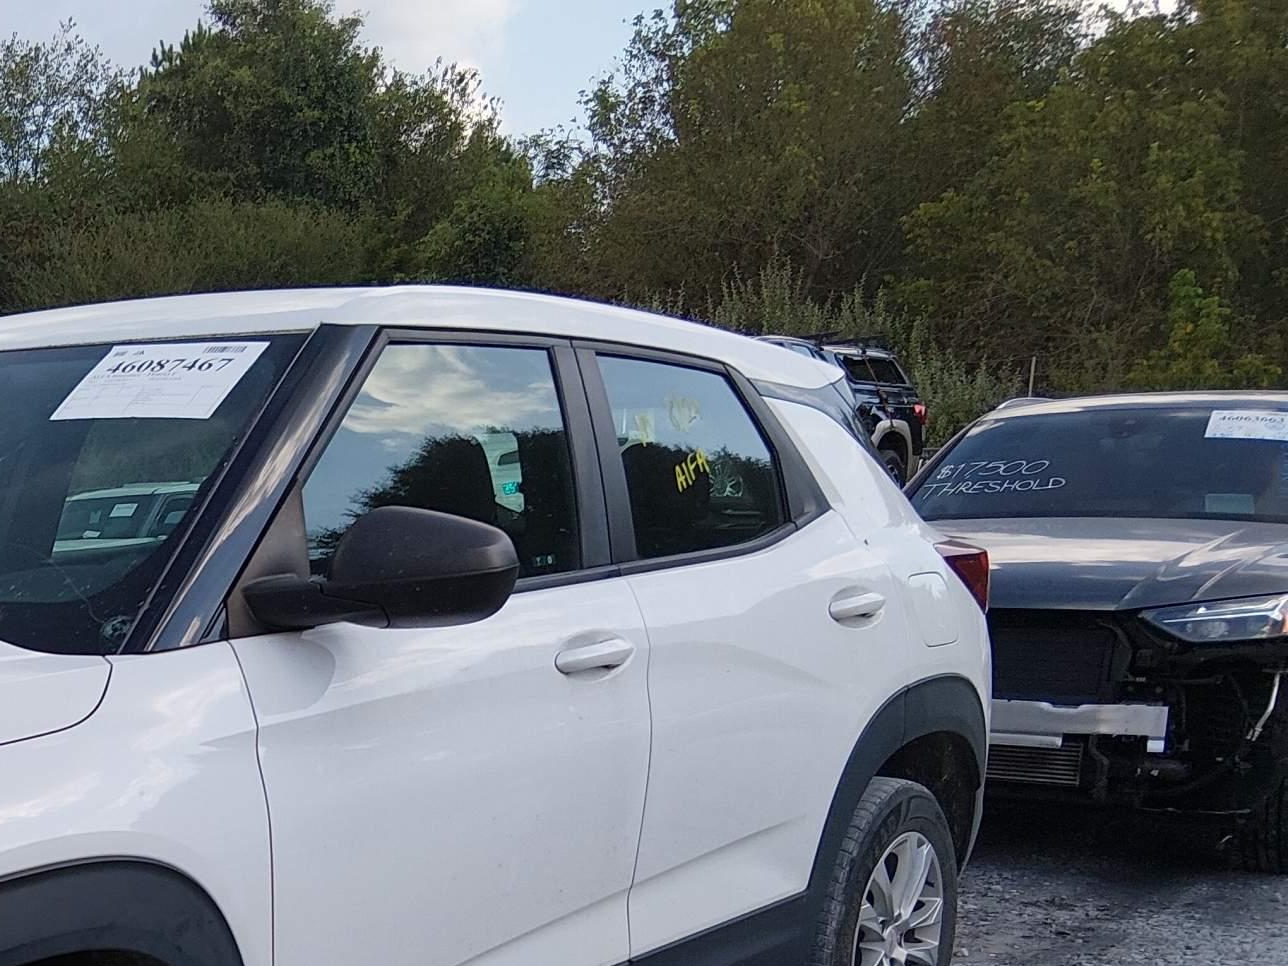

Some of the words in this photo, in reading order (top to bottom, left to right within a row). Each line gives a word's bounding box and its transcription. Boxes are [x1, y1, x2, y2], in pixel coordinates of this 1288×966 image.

[106, 358, 235, 374] 46087467
[937, 460, 1050, 480] $17500
[923, 477, 1065, 500] THRESHOLD
